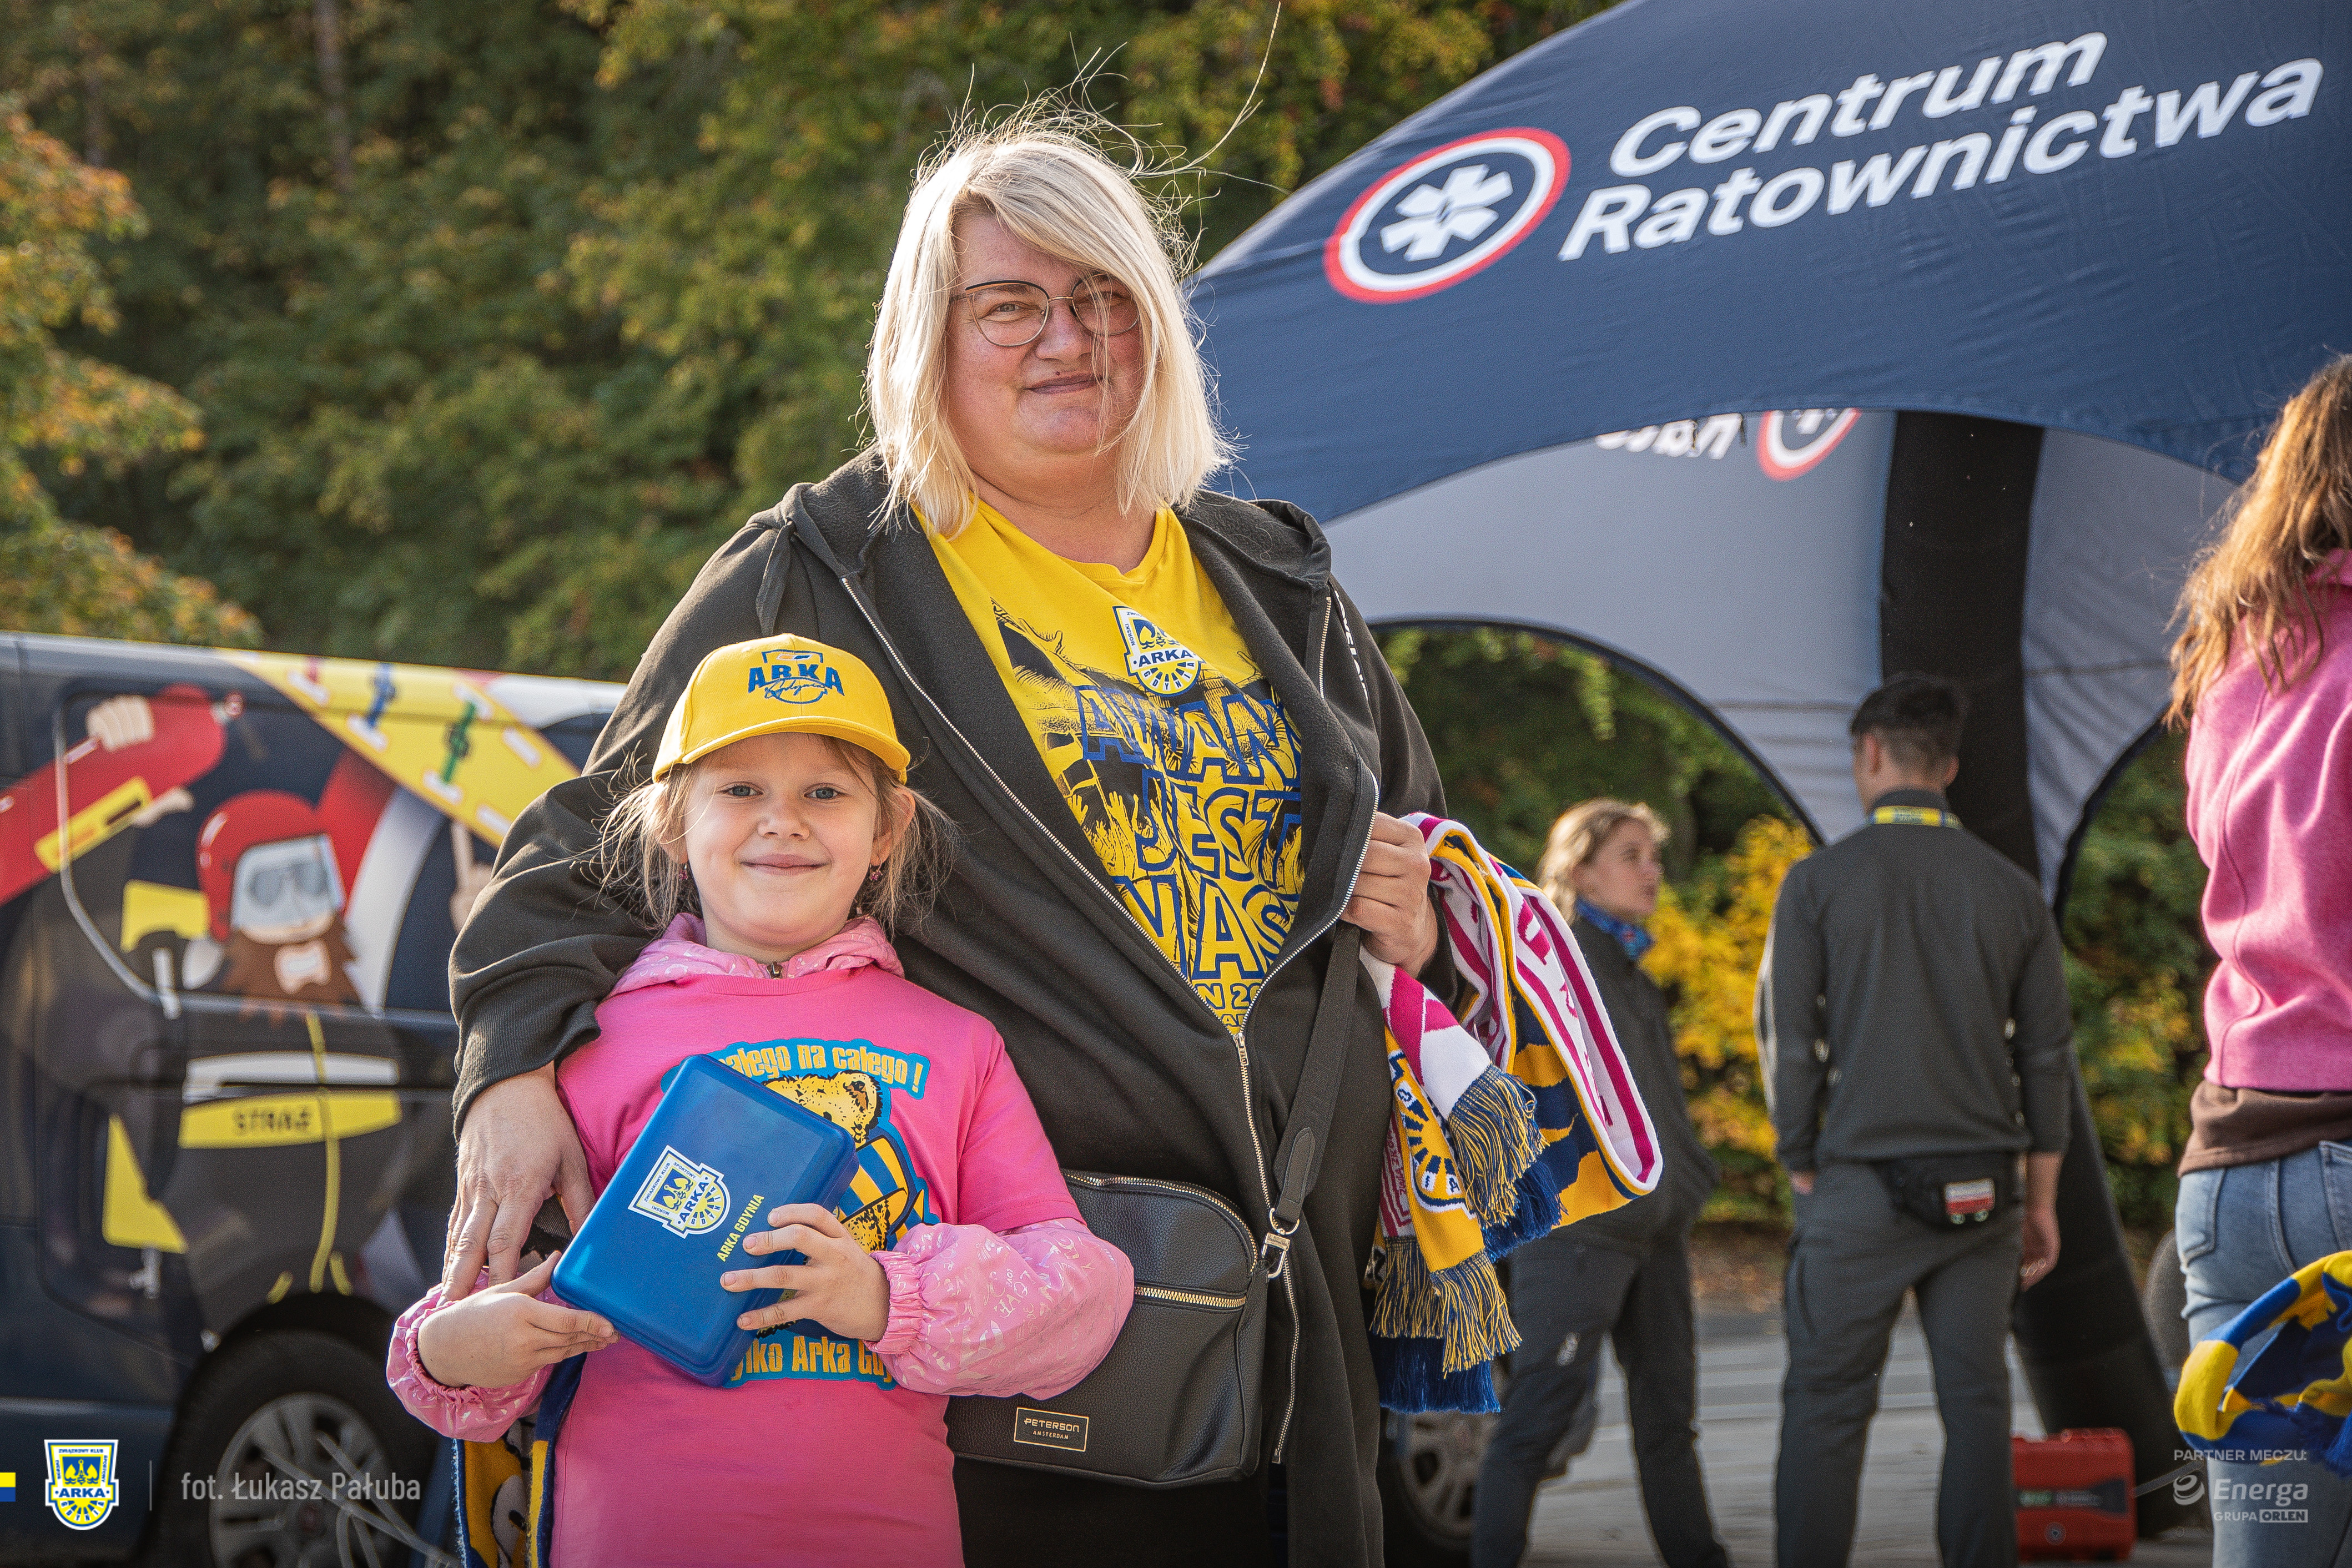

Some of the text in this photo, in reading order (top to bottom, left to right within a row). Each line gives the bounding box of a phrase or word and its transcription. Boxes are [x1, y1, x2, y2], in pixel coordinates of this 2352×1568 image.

[1610, 32, 2107, 177] Centrum
[1558, 58, 2324, 261] Ratownictwa
[1125, 623, 1136, 646] MORSKI
[1139, 649, 1194, 668] ARKA
[748, 663, 845, 696] ARKA
[718, 1045, 793, 1079] ałego
[797, 1044, 827, 1070] na
[832, 1046, 908, 1085] całego
[673, 1162, 697, 1179] SPORTOWY
[679, 1182, 710, 1223] ARKA
[717, 1194, 765, 1262] ARKA GDYNIA
[792, 1336, 851, 1373] Arka
[1024, 1418, 1080, 1433] PETERSON
[1033, 1430, 1069, 1440] AMSTERDAM
